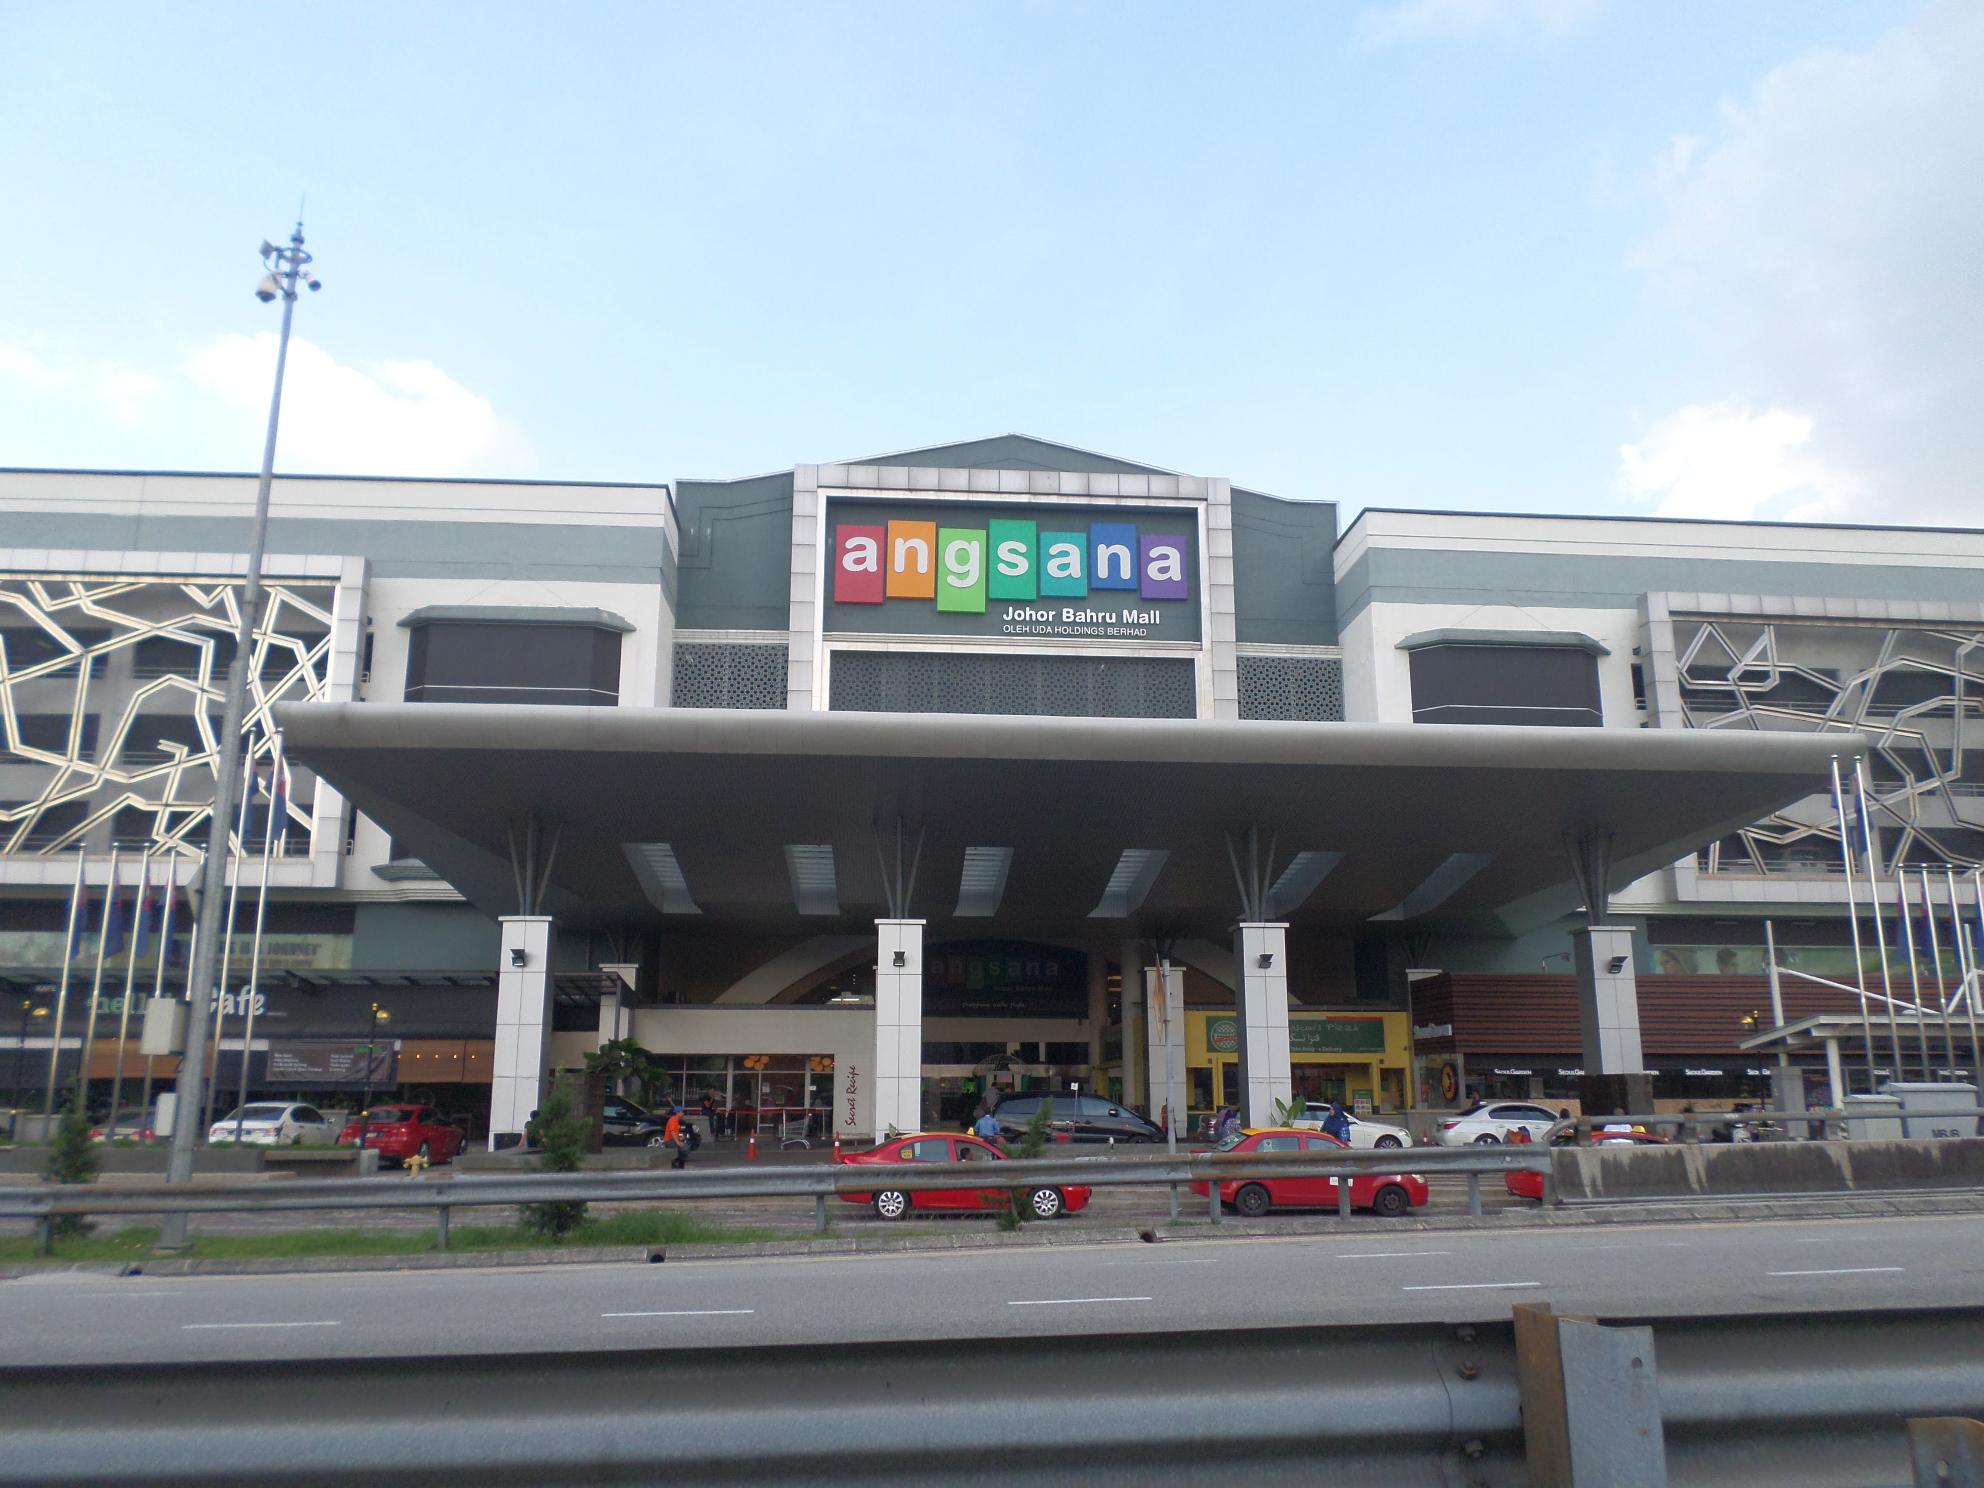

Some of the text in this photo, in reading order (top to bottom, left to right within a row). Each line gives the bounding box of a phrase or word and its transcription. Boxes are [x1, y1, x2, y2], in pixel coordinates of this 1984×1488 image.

[841, 534, 1183, 588] angsana
[1002, 606, 1160, 625] Johor Bahru Mall
[1002, 624, 1147, 637] OLEH UDA HOLDINGS BERHAD
[930, 958, 1058, 979] angsana
[844, 1064, 861, 1127] Secret Recipe
